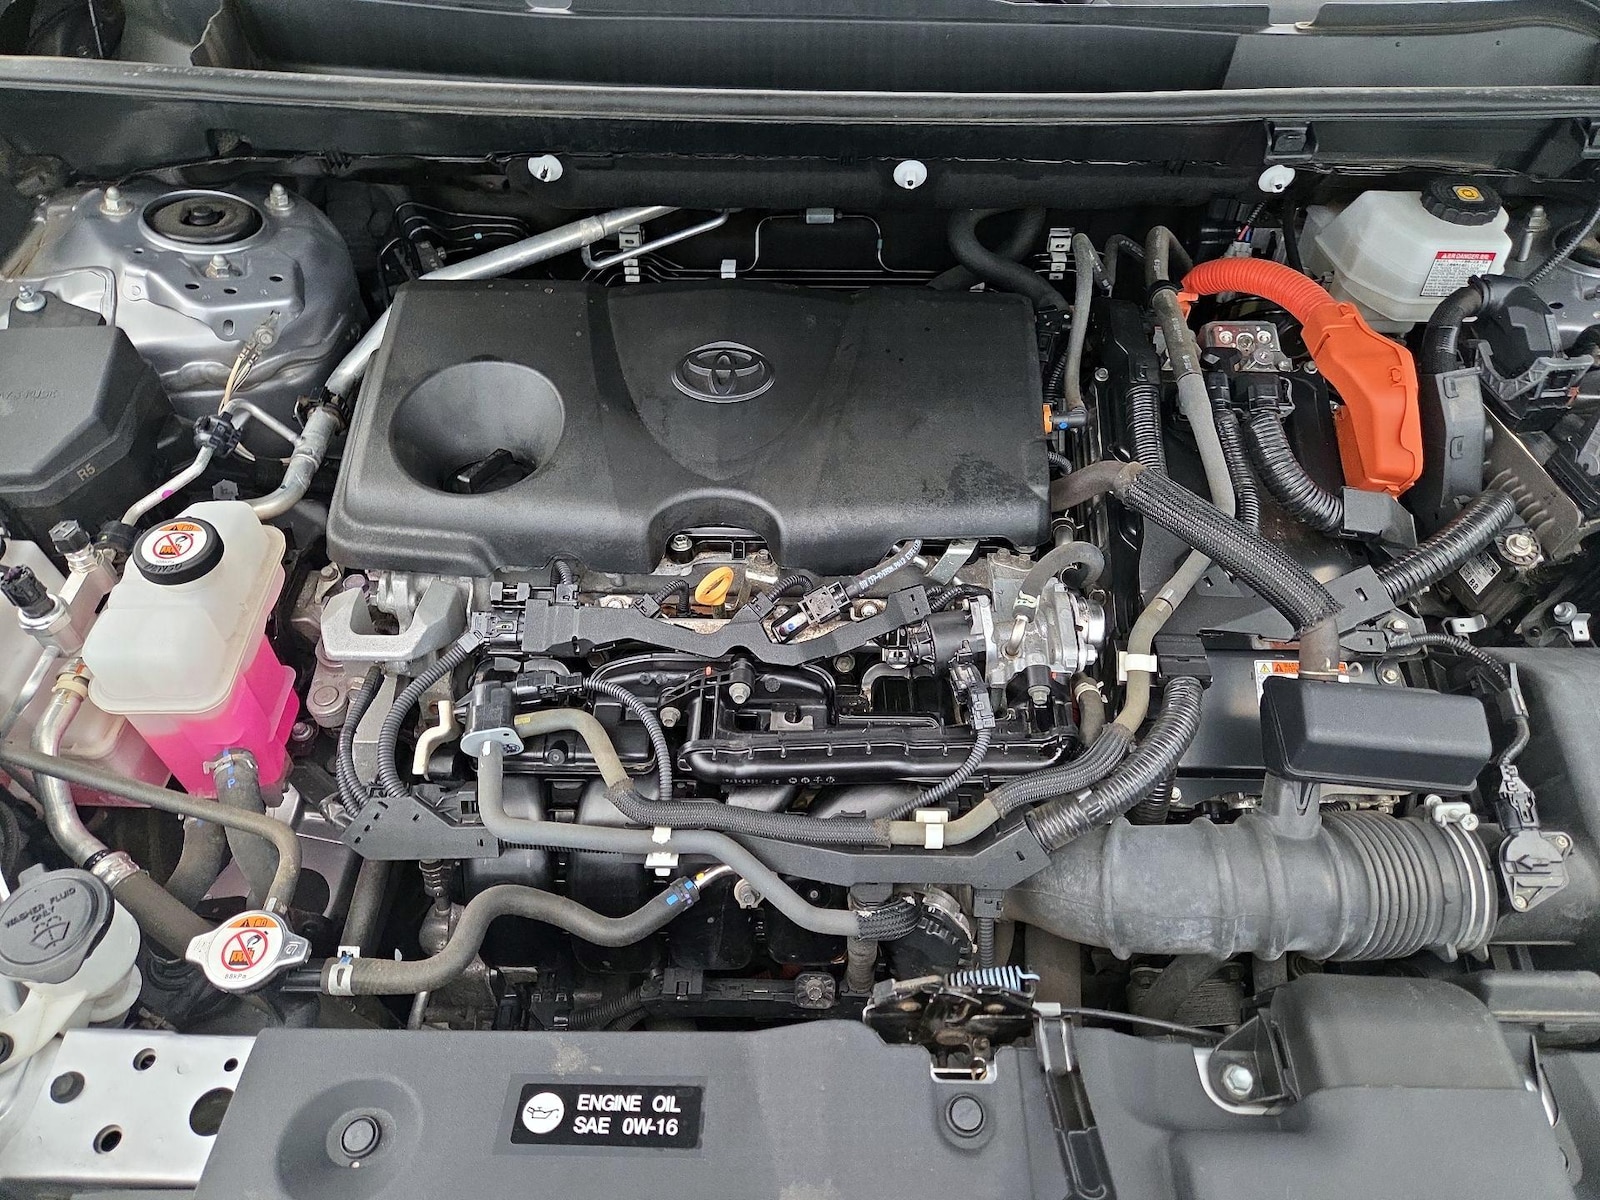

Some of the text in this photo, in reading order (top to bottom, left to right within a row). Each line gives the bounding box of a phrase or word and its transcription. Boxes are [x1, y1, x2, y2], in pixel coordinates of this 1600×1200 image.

[76, 463, 96, 481] R5
[5, 887, 76, 928] WASHER FLUID
[31, 906, 55, 923] ONLY
[576, 1094, 681, 1113] ENGINE OIL
[573, 1117, 679, 1136] SAE 0W-16
